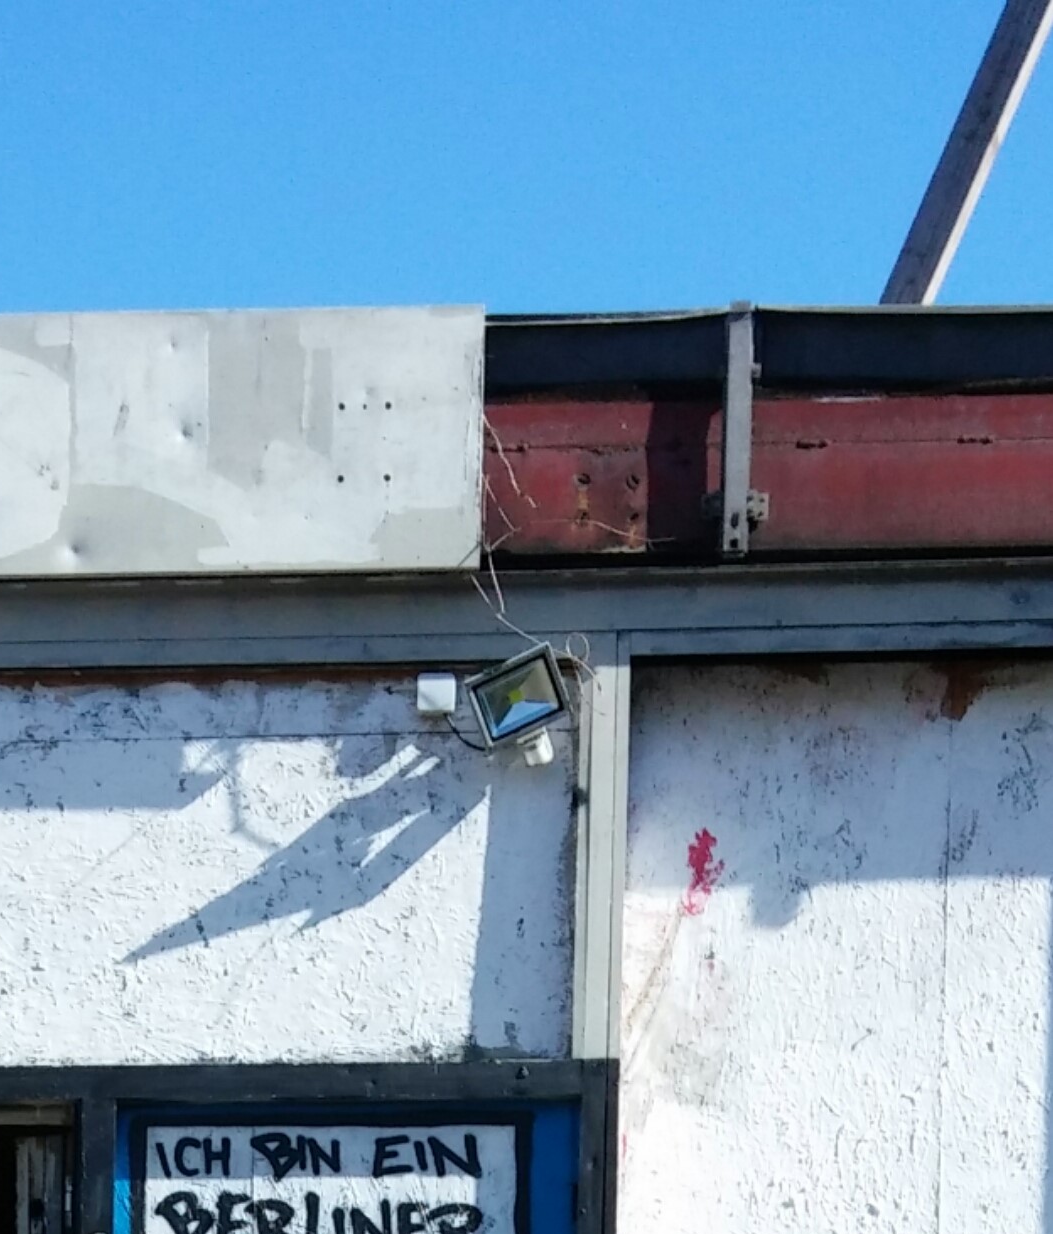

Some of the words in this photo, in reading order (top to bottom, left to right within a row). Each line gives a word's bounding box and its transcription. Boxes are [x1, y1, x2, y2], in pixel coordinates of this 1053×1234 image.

[155, 1137, 231, 1179] ICH
[250, 1132, 341, 1182] BIN
[373, 1133, 483, 1179] EIN
